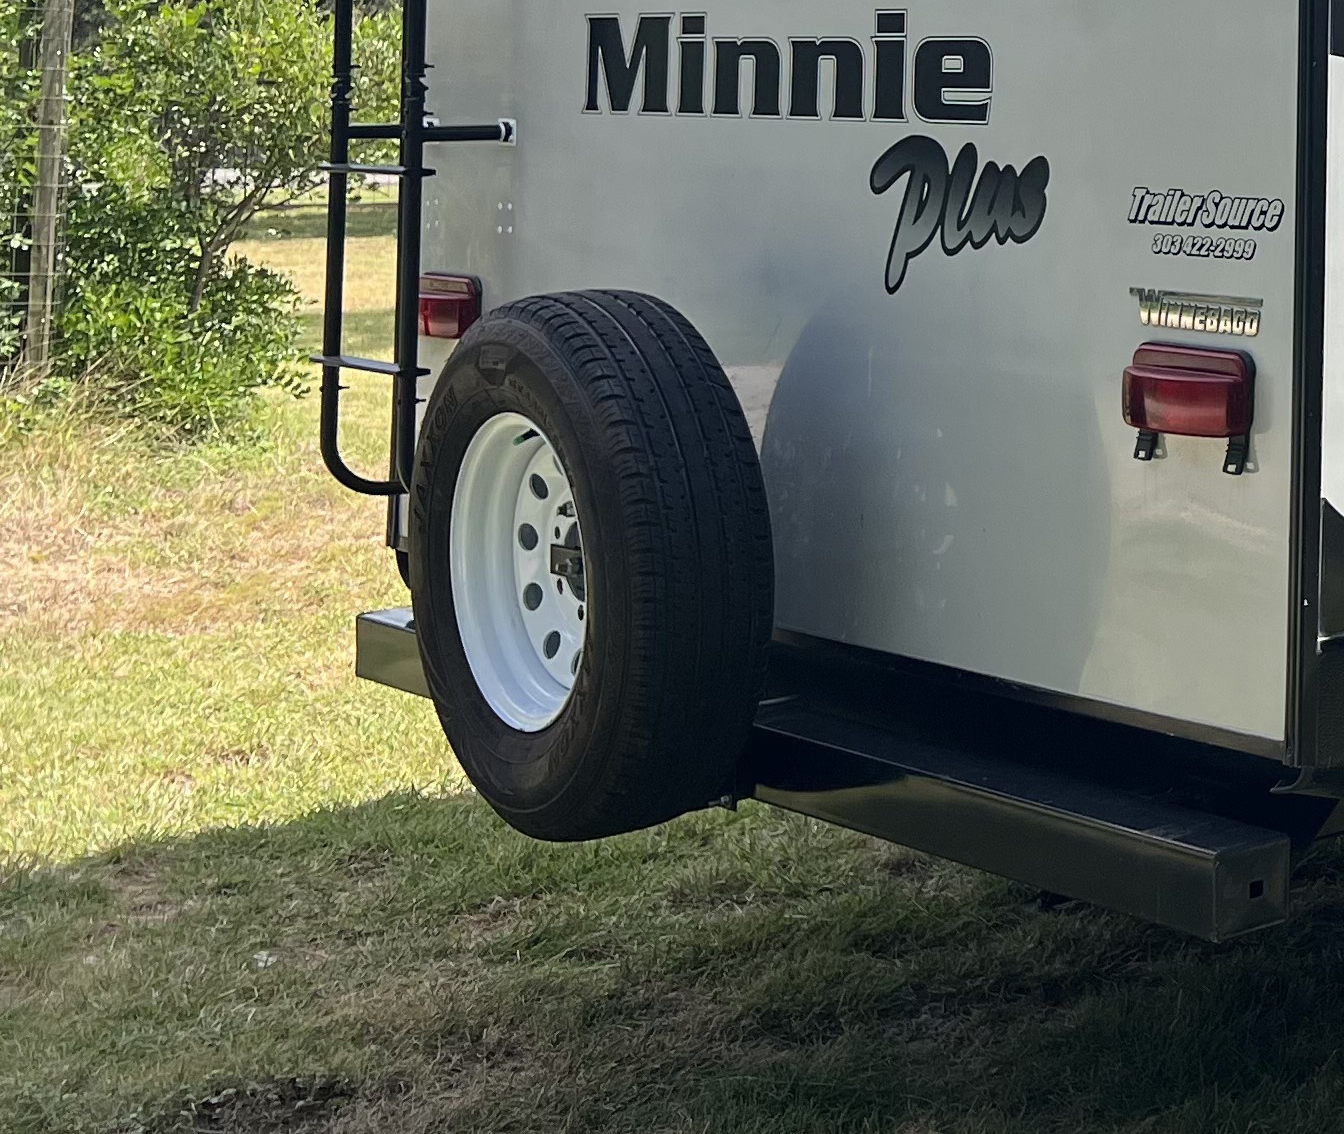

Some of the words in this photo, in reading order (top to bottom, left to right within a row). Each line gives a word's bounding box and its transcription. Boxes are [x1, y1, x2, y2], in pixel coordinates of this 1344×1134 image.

[581, 8, 994, 125] Minnie
[870, 134, 1050, 294] Plus
[1127, 187, 1205, 227] Trailer
[1200, 190, 1285, 232] Source
[1152, 233, 1184, 255] 303
[1182, 236, 1257, 260] 422-2999
